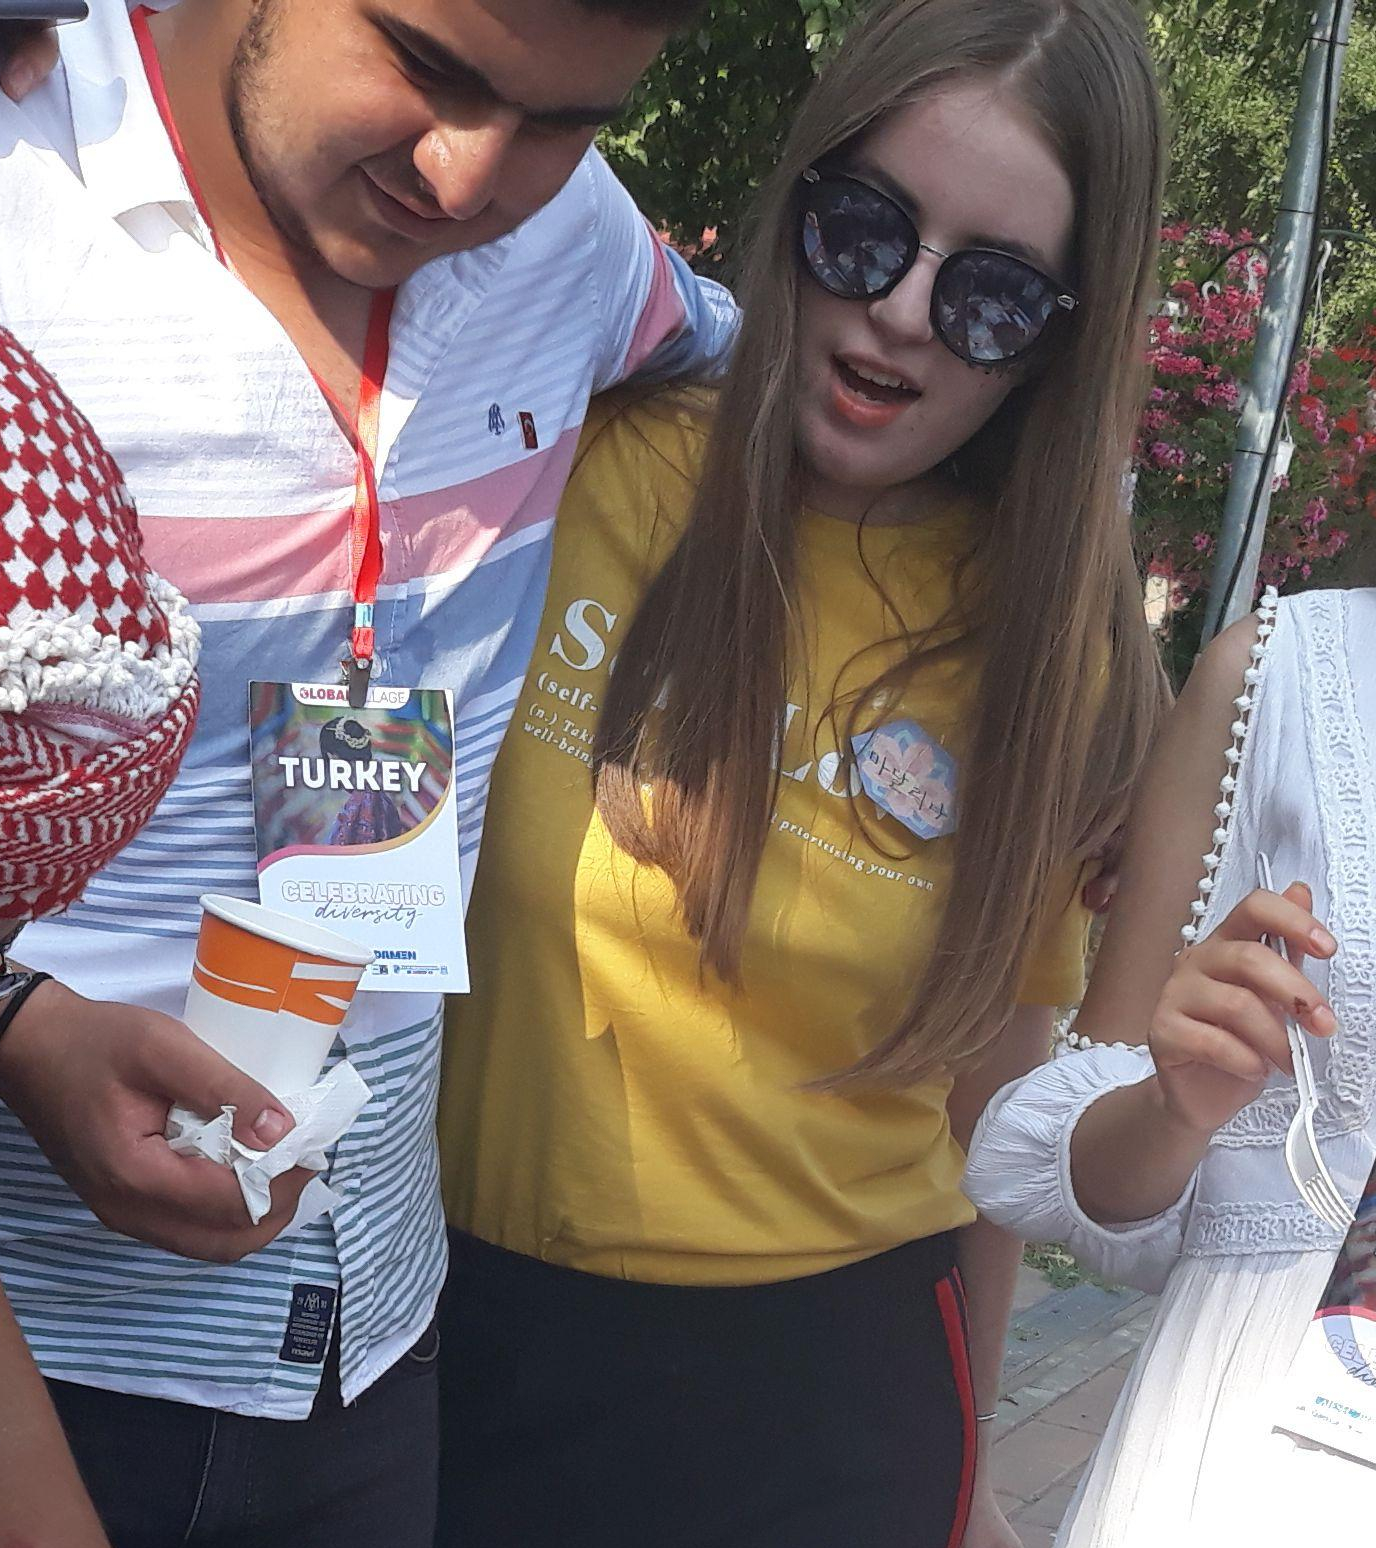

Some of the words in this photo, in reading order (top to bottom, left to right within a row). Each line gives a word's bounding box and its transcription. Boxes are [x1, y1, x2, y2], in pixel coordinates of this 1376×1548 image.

[368, 687, 405, 704] LAGE
[563, 719, 595, 744] Taki
[278, 756, 428, 793] TURKEY
[866, 862, 904, 882] your
[908, 874, 935, 892] own
[281, 879, 446, 907] CELEBRATING
[314, 897, 423, 929] diversity
